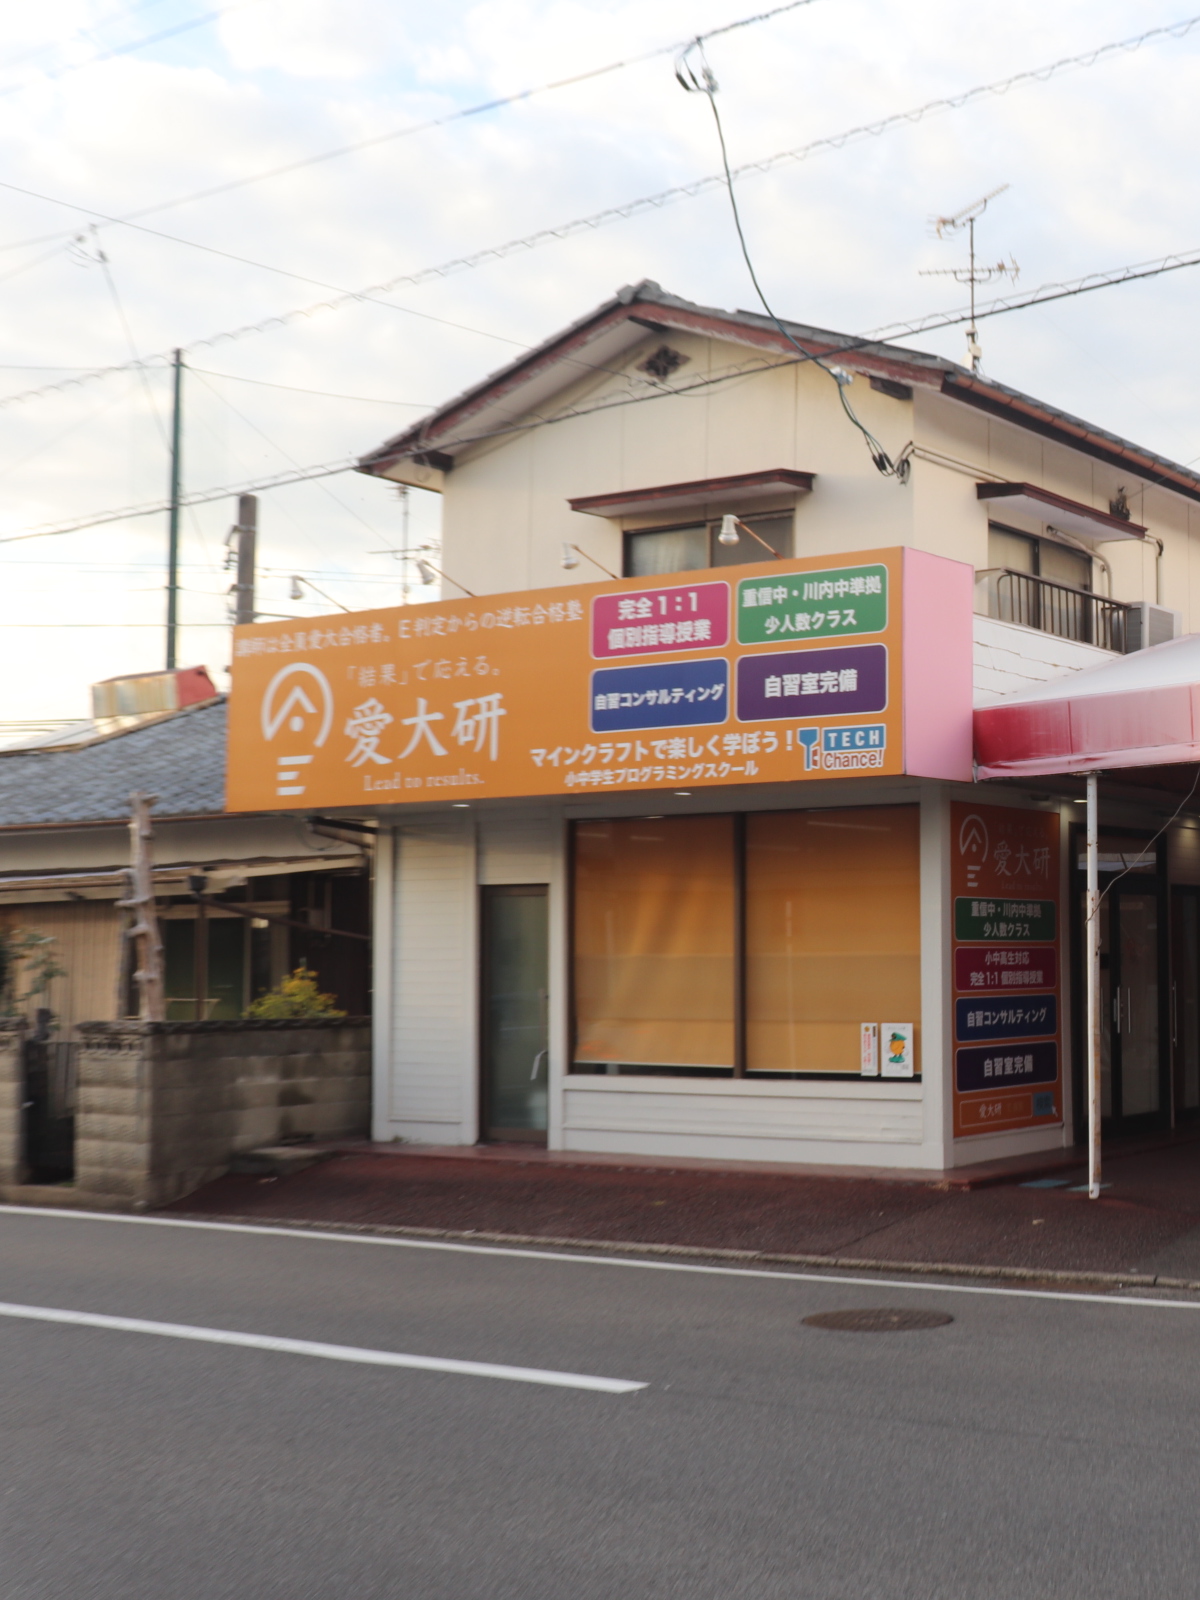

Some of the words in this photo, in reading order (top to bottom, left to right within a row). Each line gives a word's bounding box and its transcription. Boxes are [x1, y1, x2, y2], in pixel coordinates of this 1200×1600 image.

[742, 575, 882, 608] 重信中・川内中準拠
[607, 618, 712, 650] 個別指導授業
[764, 608, 858, 635] 少人数クラス
[594, 682, 726, 711] 自習コンサルティング
[764, 668, 858, 698] 自習室完備
[344, 692, 507, 768] 愛大研
[828, 730, 881, 748] TECH
[823, 750, 883, 769] Chance!
[363, 772, 402, 792] Lead
[405, 773, 422, 790] to
[426, 768, 486, 789] results.
[564, 761, 759, 788] 小中学生プログラミングスクール
[993, 839, 1051, 879] 愛大研
[983, 922, 1031, 938] 少人数クラス
[985, 951, 1030, 966] 小中高生対応
[967, 1007, 1048, 1028] 自習コンサルティング
[983, 1055, 1034, 1078] 自習室完備
